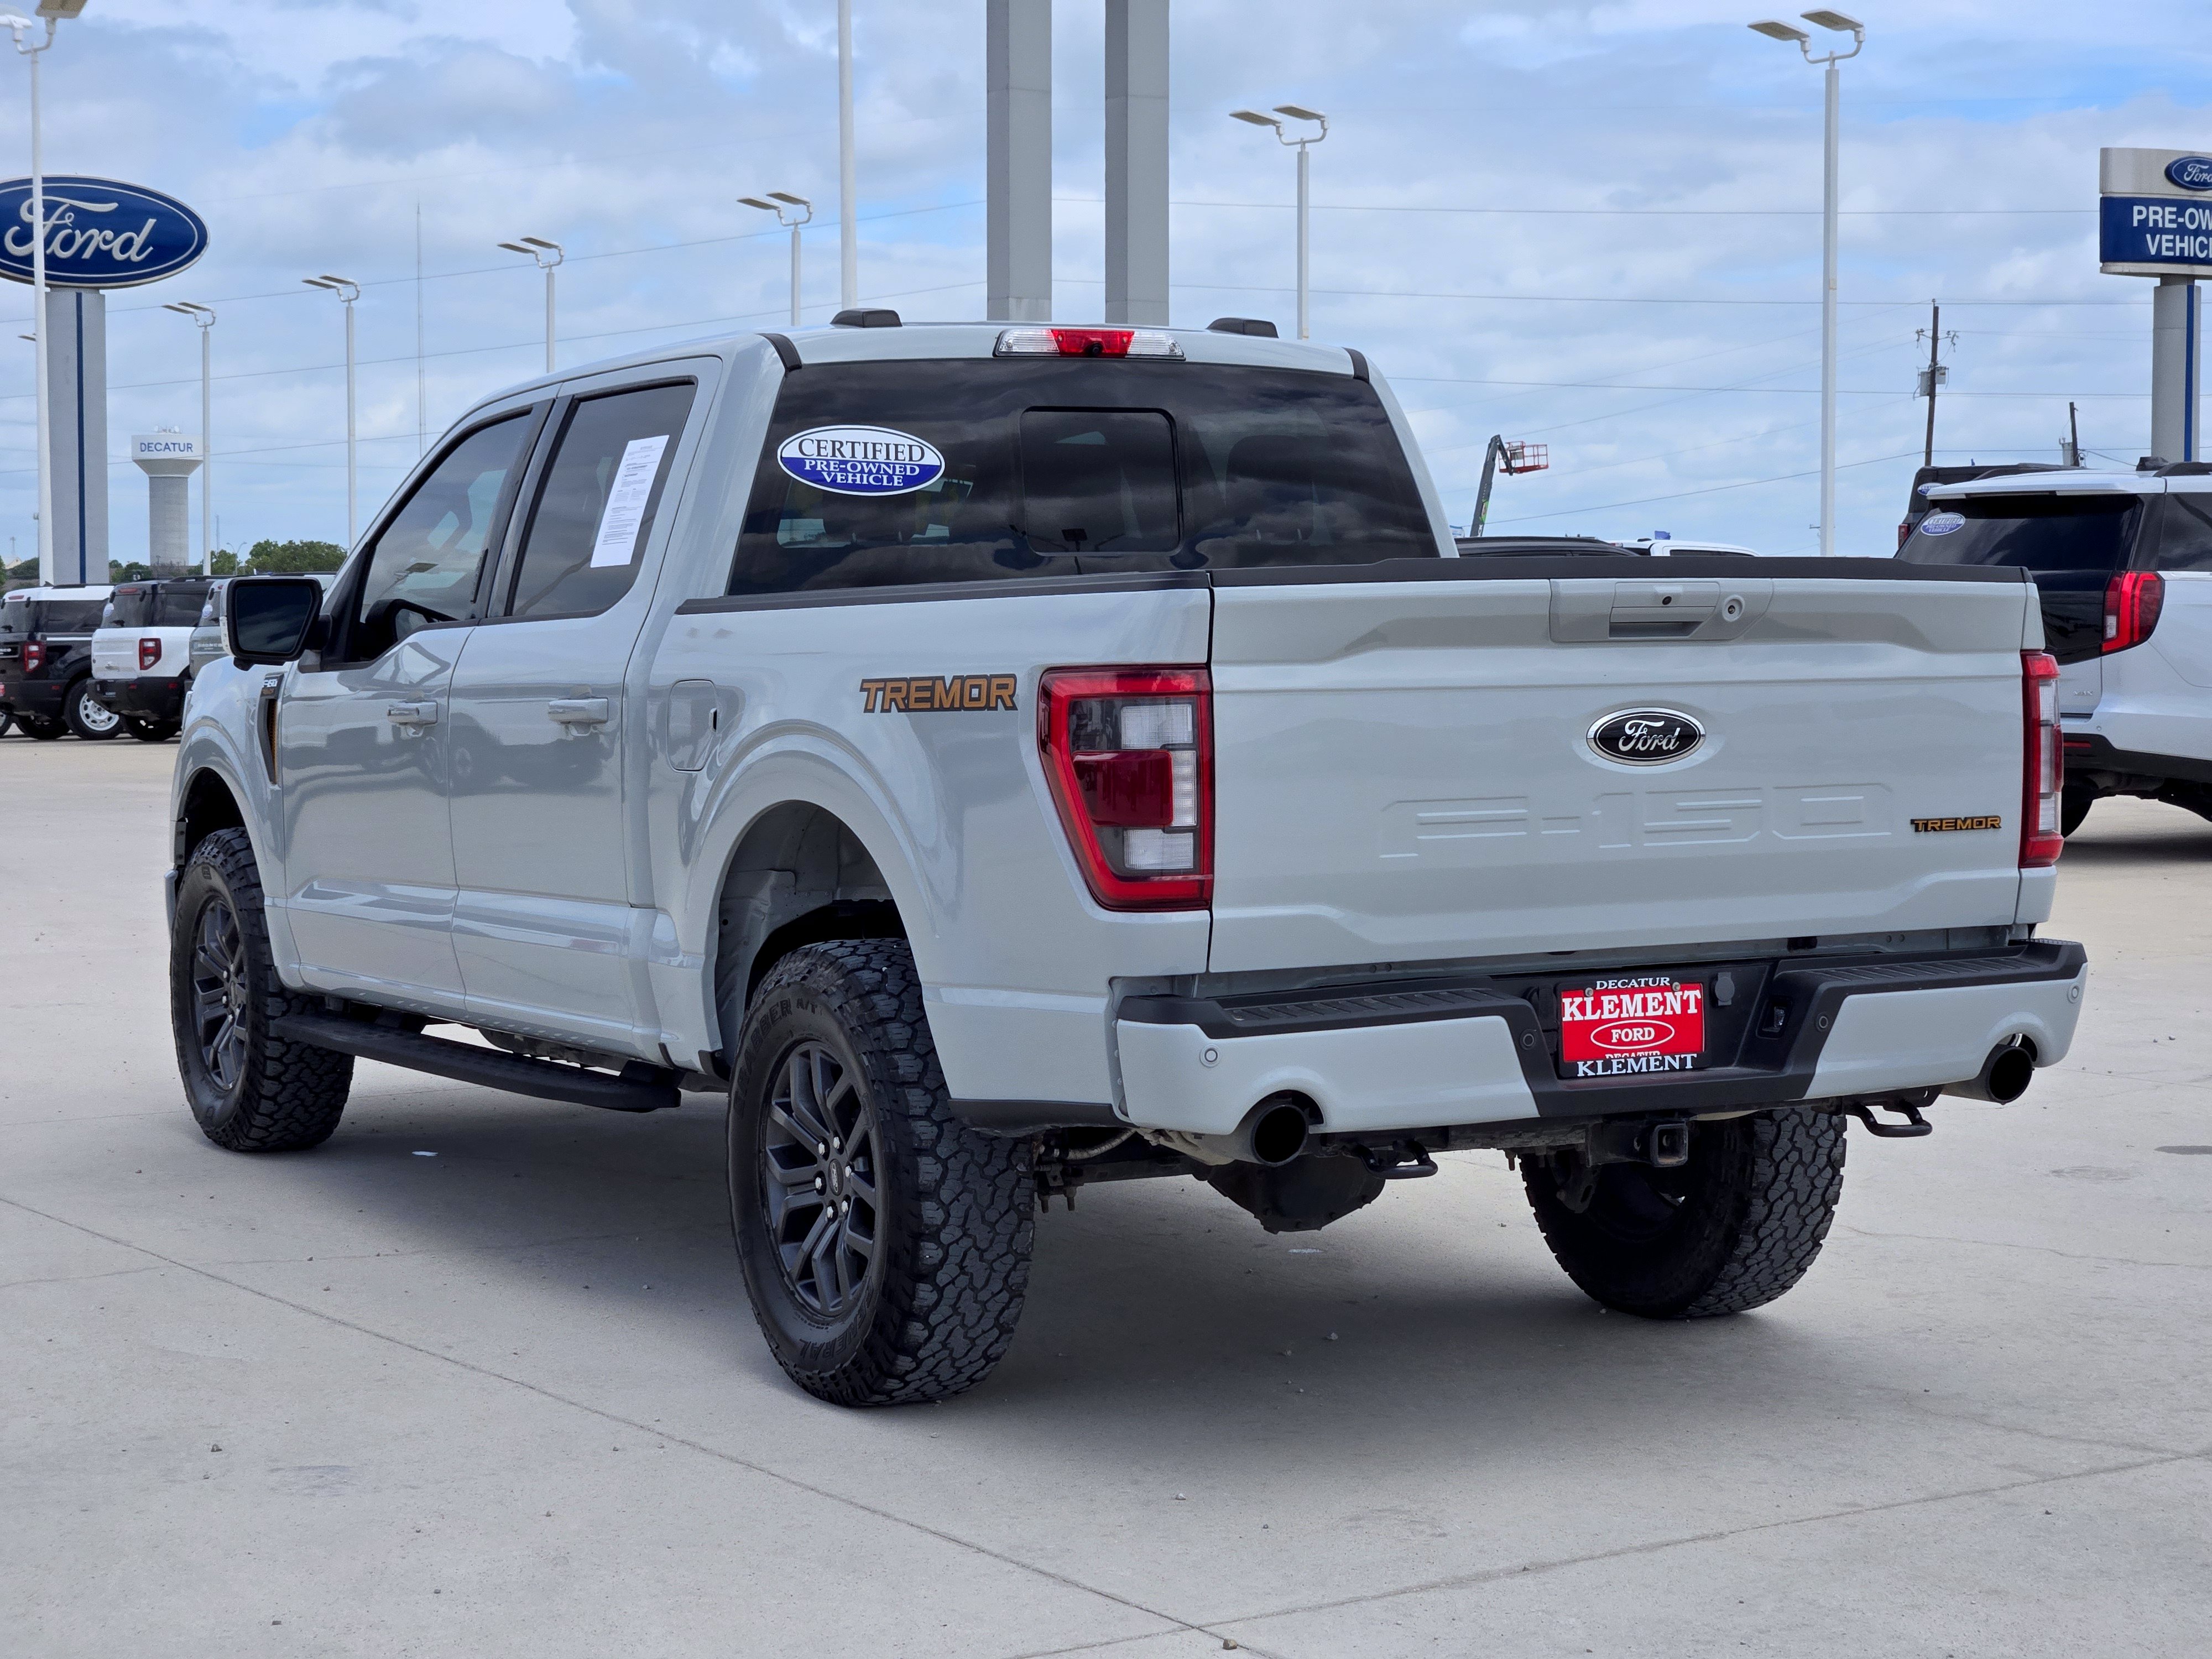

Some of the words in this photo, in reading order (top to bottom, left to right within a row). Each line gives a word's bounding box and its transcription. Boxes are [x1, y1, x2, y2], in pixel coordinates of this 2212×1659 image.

[4, 196, 157, 262] Ford
[140, 442, 193, 452] DECATUR
[798, 438, 925, 462] CERTIFIED
[804, 459, 920, 476] PRE-OWNED
[821, 472, 904, 486] VEHICLE
[859, 674, 1018, 713] TREMOR
[1618, 719, 1681, 752] Ford
[1910, 815, 2002, 832] TREMOR
[1596, 977, 1670, 990] DECATUR
[1562, 990, 1702, 1021] KLEMENT
[1611, 1027, 1655, 1042] FORD
[1577, 1053, 1697, 1077] KLEMENT
